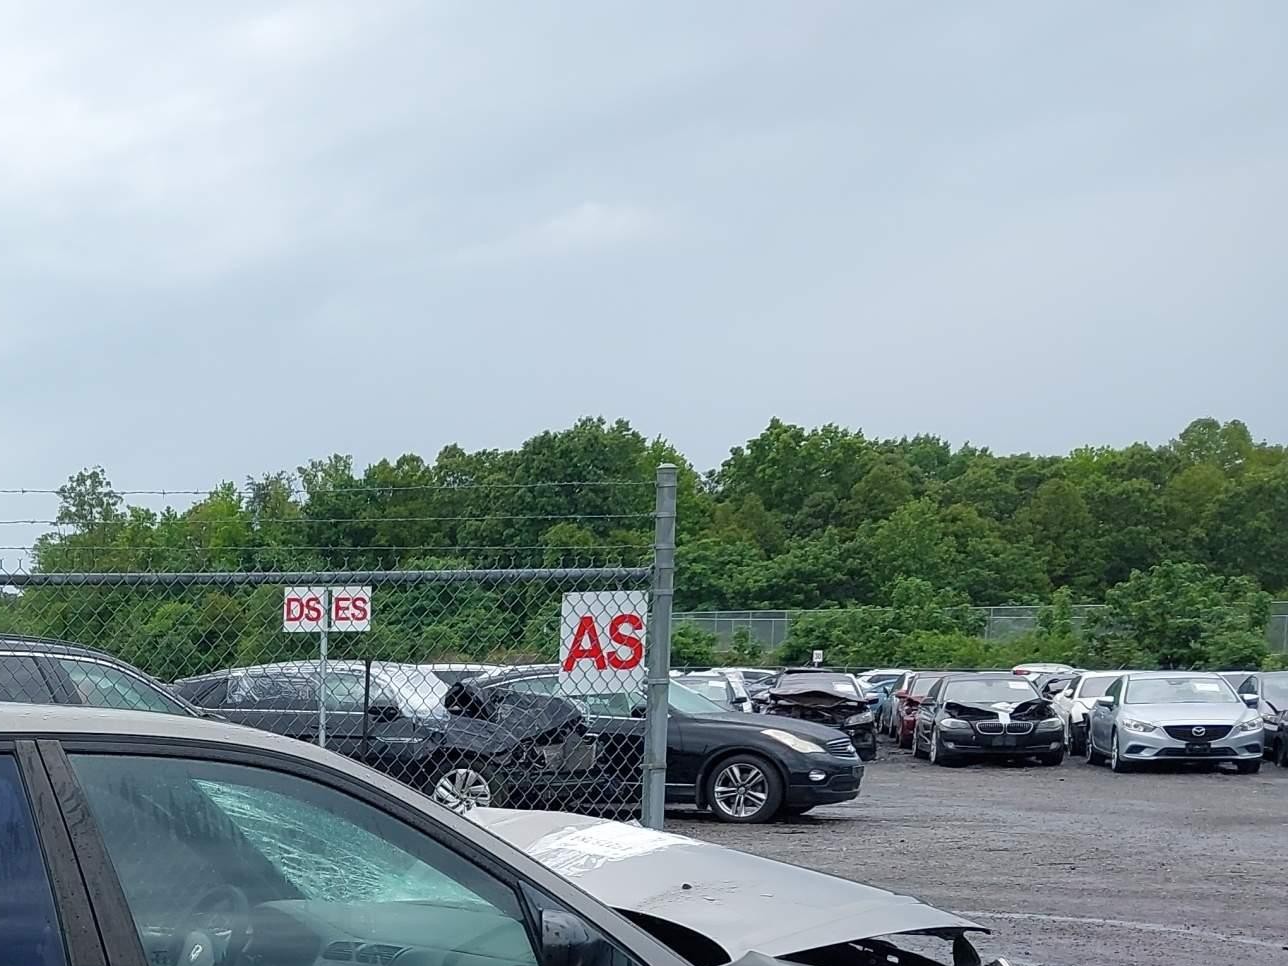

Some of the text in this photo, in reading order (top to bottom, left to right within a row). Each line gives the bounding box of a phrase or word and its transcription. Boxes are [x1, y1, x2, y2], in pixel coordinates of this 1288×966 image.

[286, 597, 321, 622] DS
[334, 597, 368, 621] ES
[563, 614, 643, 672] AS
